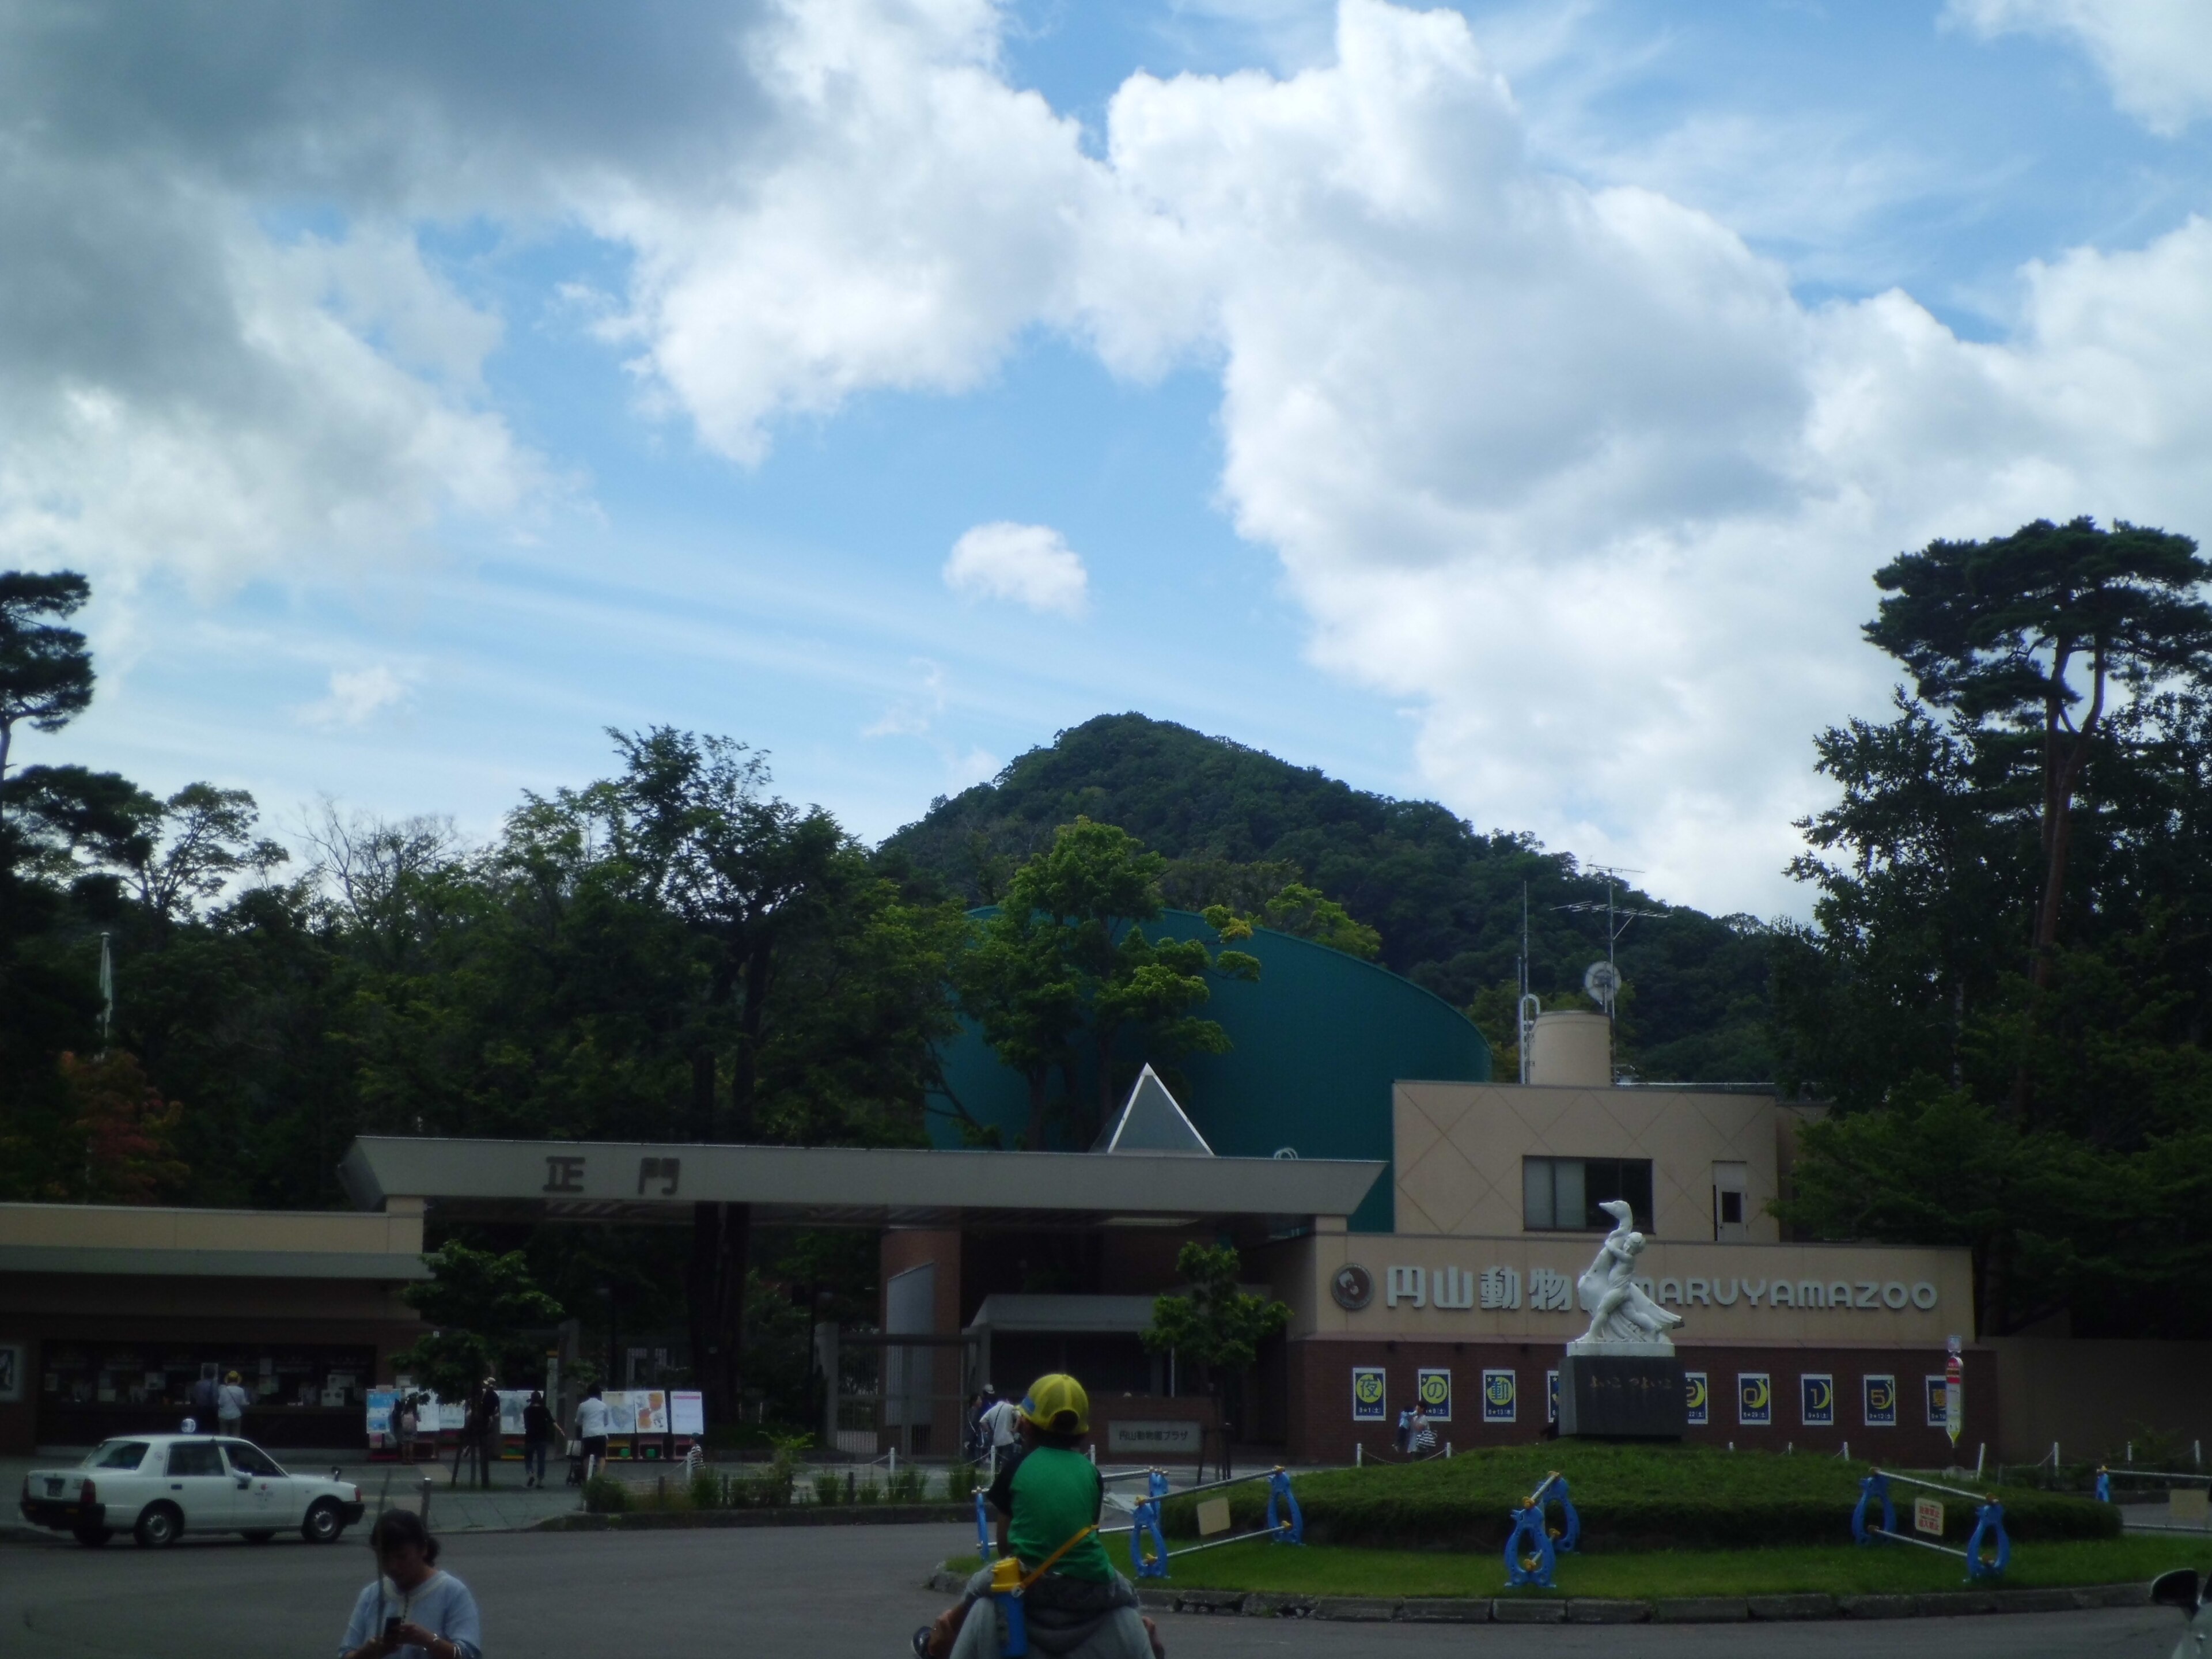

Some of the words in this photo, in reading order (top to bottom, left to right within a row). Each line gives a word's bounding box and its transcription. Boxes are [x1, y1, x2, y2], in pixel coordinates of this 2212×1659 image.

[1387, 1265, 1588, 1310] 円山動物
[1360, 1378, 1378, 1398] 夜
[1427, 1381, 1445, 1399] の
[1491, 1381, 1509, 1400] 動
[1743, 1387, 1758, 1405] 0
[1810, 1388, 1818, 1405] 1
[1870, 1388, 1886, 1406] 5
